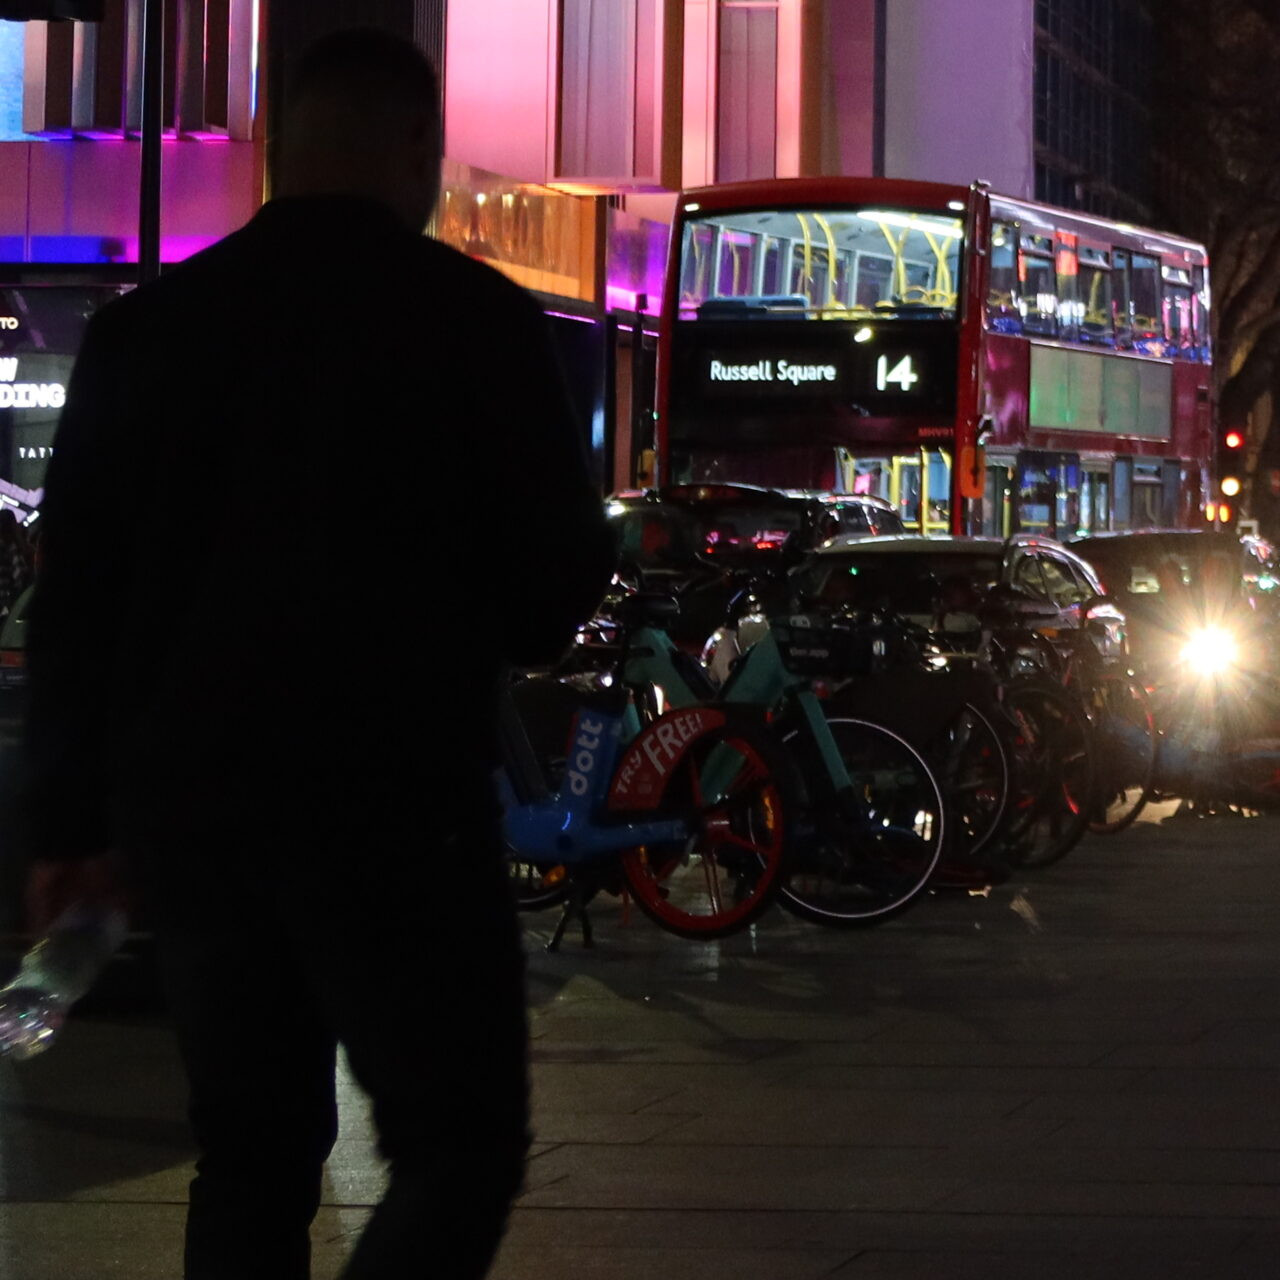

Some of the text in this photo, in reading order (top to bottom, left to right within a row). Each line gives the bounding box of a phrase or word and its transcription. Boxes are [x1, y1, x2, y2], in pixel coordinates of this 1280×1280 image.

[710, 354, 919, 391] Russell Square 14
[567, 718, 604, 797] dott
[615, 711, 705, 794] TRY FREE!
